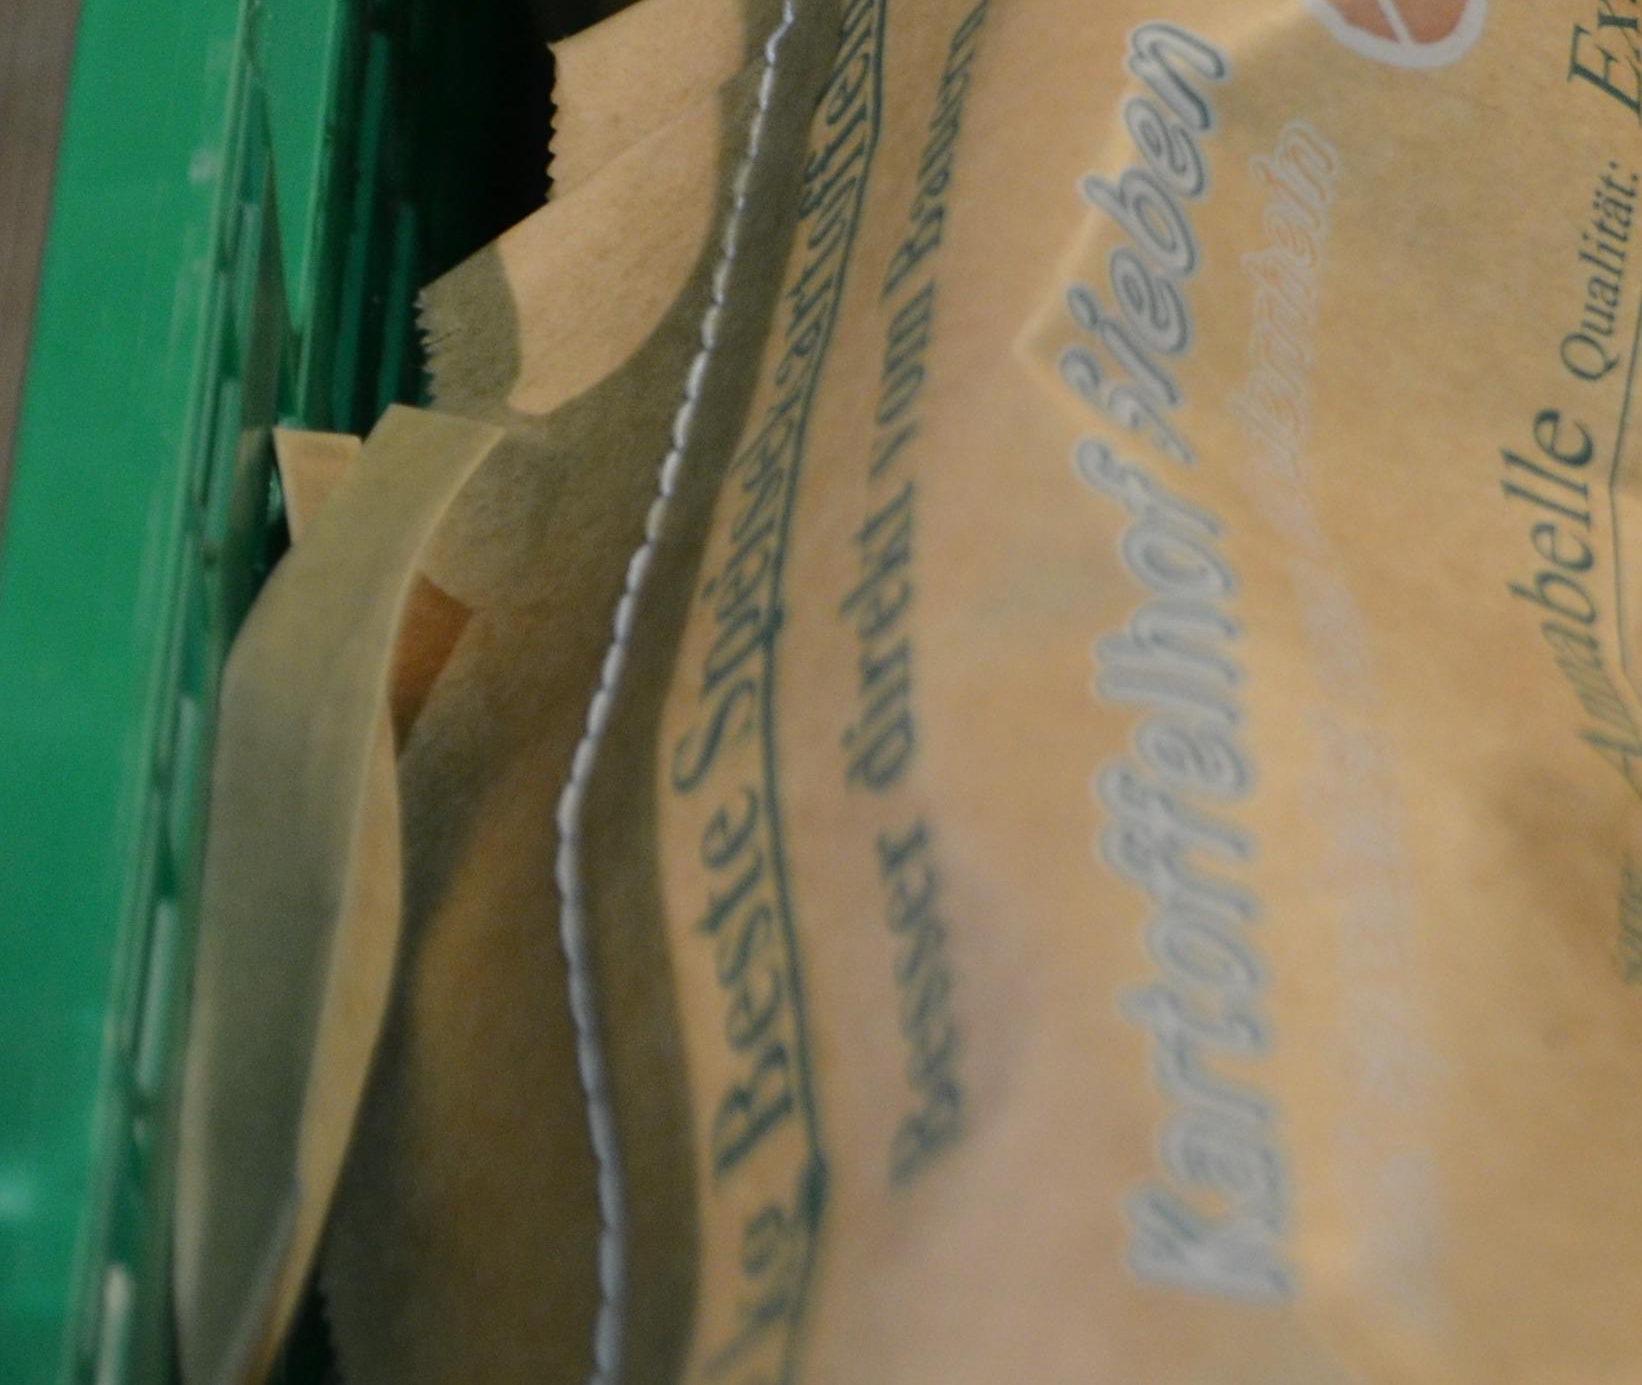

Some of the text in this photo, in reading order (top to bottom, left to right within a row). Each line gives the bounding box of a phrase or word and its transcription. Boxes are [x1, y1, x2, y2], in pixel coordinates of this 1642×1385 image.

[868, 276, 938, 482] vom
[1559, 159, 1640, 384] Qualität:
[838, 482, 920, 796] direkt
[699, 786, 800, 1183] Beste
[880, 817, 966, 1194] Besser
[1074, 432, 1300, 1308] Kartoffelhof
